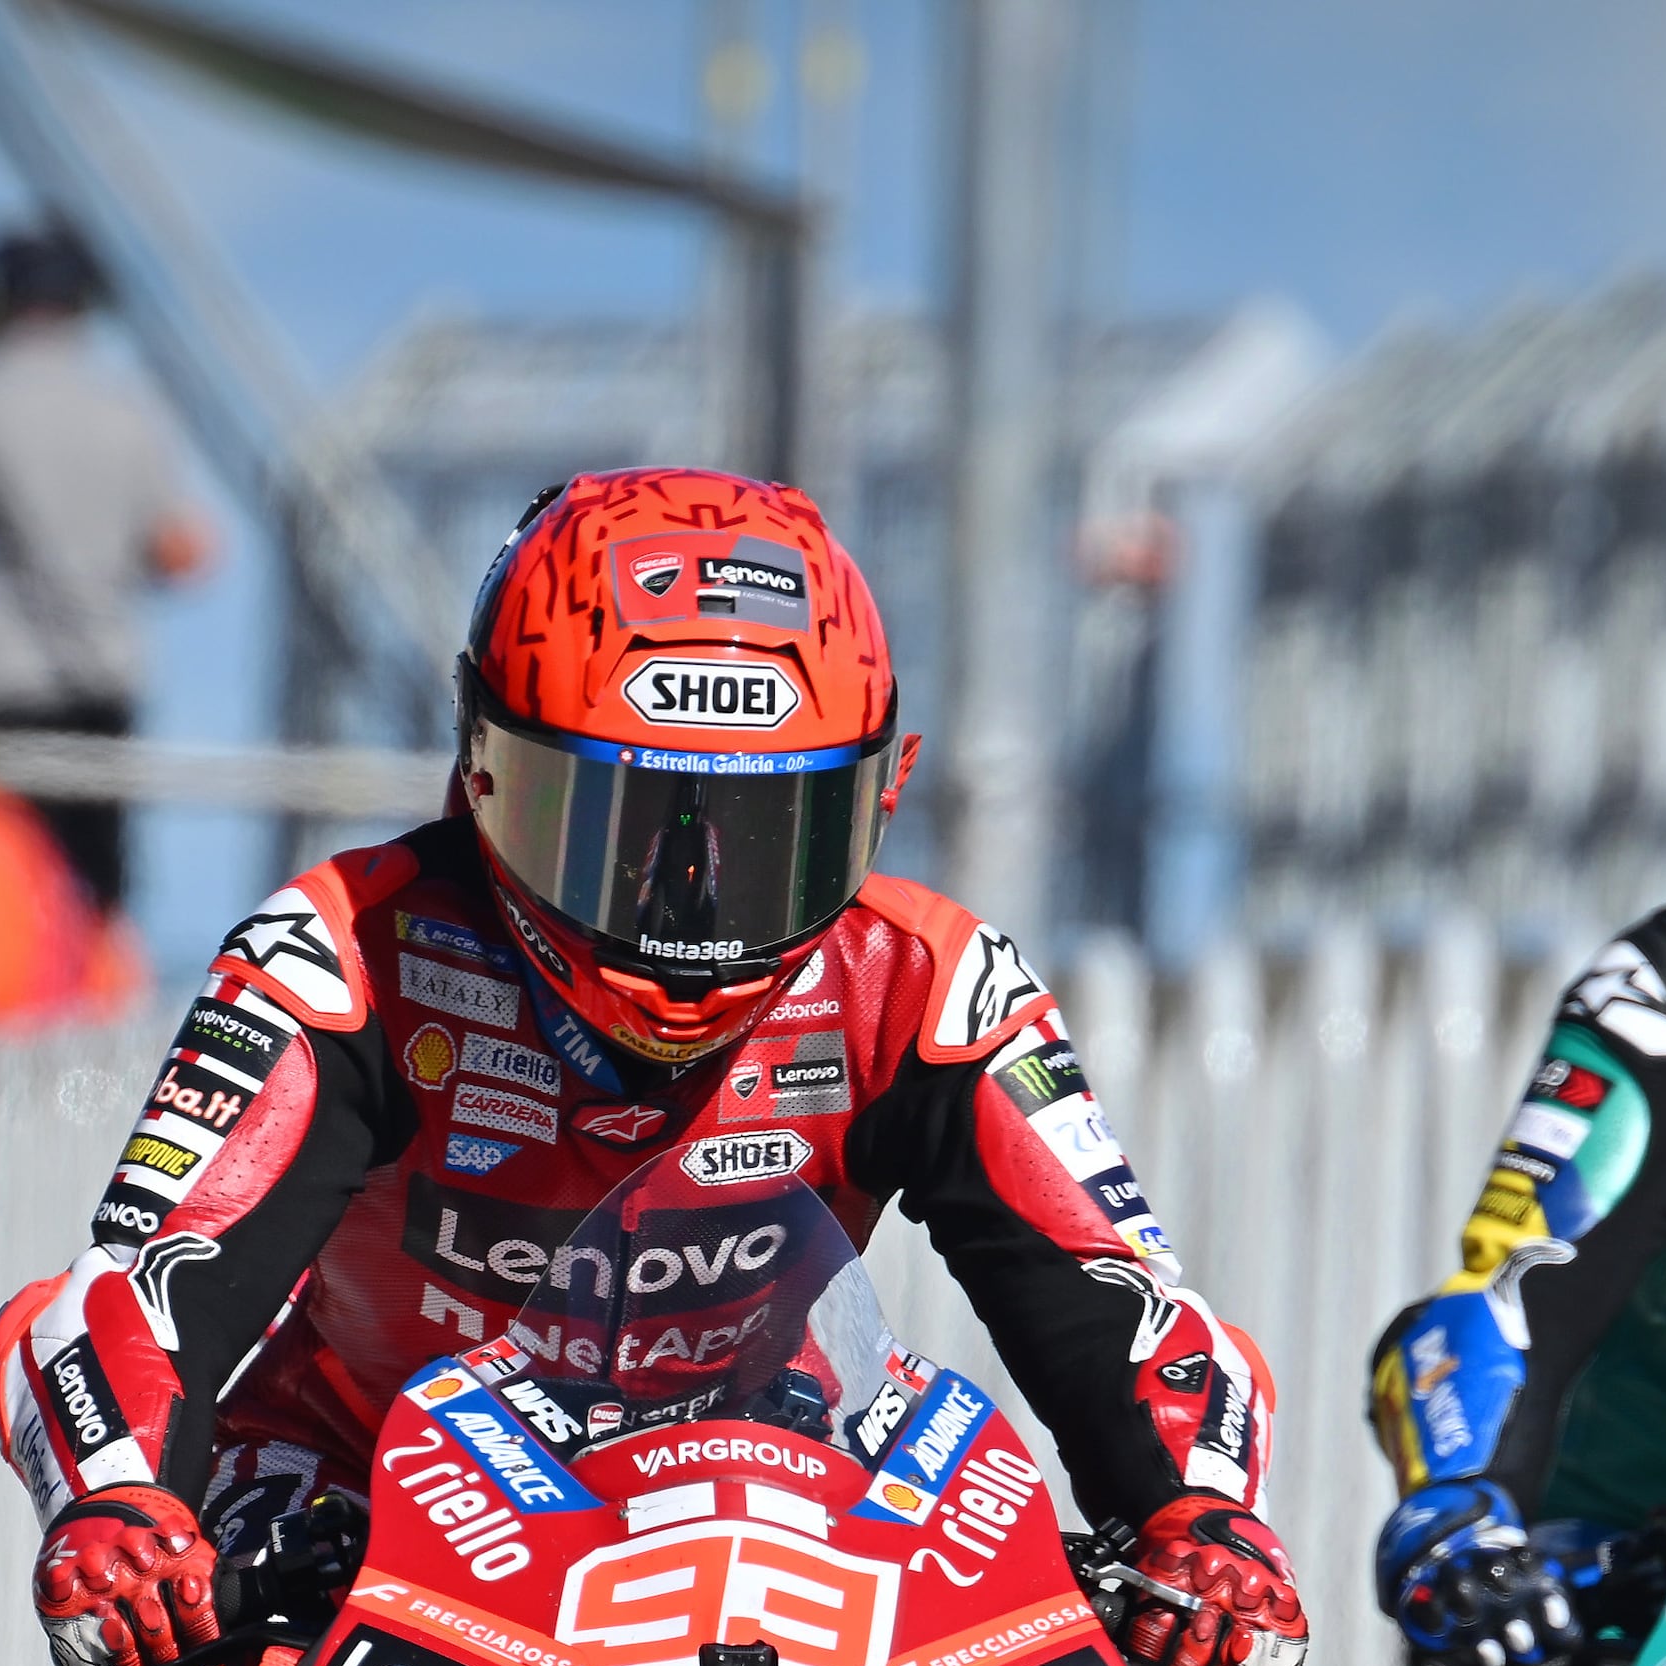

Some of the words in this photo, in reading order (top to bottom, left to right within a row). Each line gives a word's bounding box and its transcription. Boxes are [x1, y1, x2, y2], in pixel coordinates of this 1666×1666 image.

[705, 561, 797, 591] Lenovo
[651, 673, 776, 715] SHOEI
[640, 750, 710, 773] Estrella
[712, 751, 775, 774] Galicia
[639, 934, 744, 961] Insta360
[410, 968, 510, 1011] EATALY
[193, 1025, 254, 1055] ENERGY
[553, 1015, 603, 1077] TIM
[491, 1047, 557, 1087] riello
[776, 1066, 840, 1083] Lenovo
[457, 1091, 556, 1132] CARRERA
[446, 1140, 503, 1172] SAP
[701, 1141, 792, 1176] SHOEI
[434, 1207, 787, 1301] Lenovo
[509, 1303, 771, 1375] NetApp
[53, 1346, 109, 1445] Lenovo
[500, 1379, 583, 1444] WPS
[856, 1381, 908, 1457] WPS
[909, 1386, 984, 1483] ADVANCE
[1207, 1382, 1248, 1459] Lenov
[444, 1410, 565, 1506] ADVANCE
[632, 1437, 828, 1480] VARGROUP
[398, 1461, 532, 1583] riello
[941, 1446, 1043, 1562] riello
